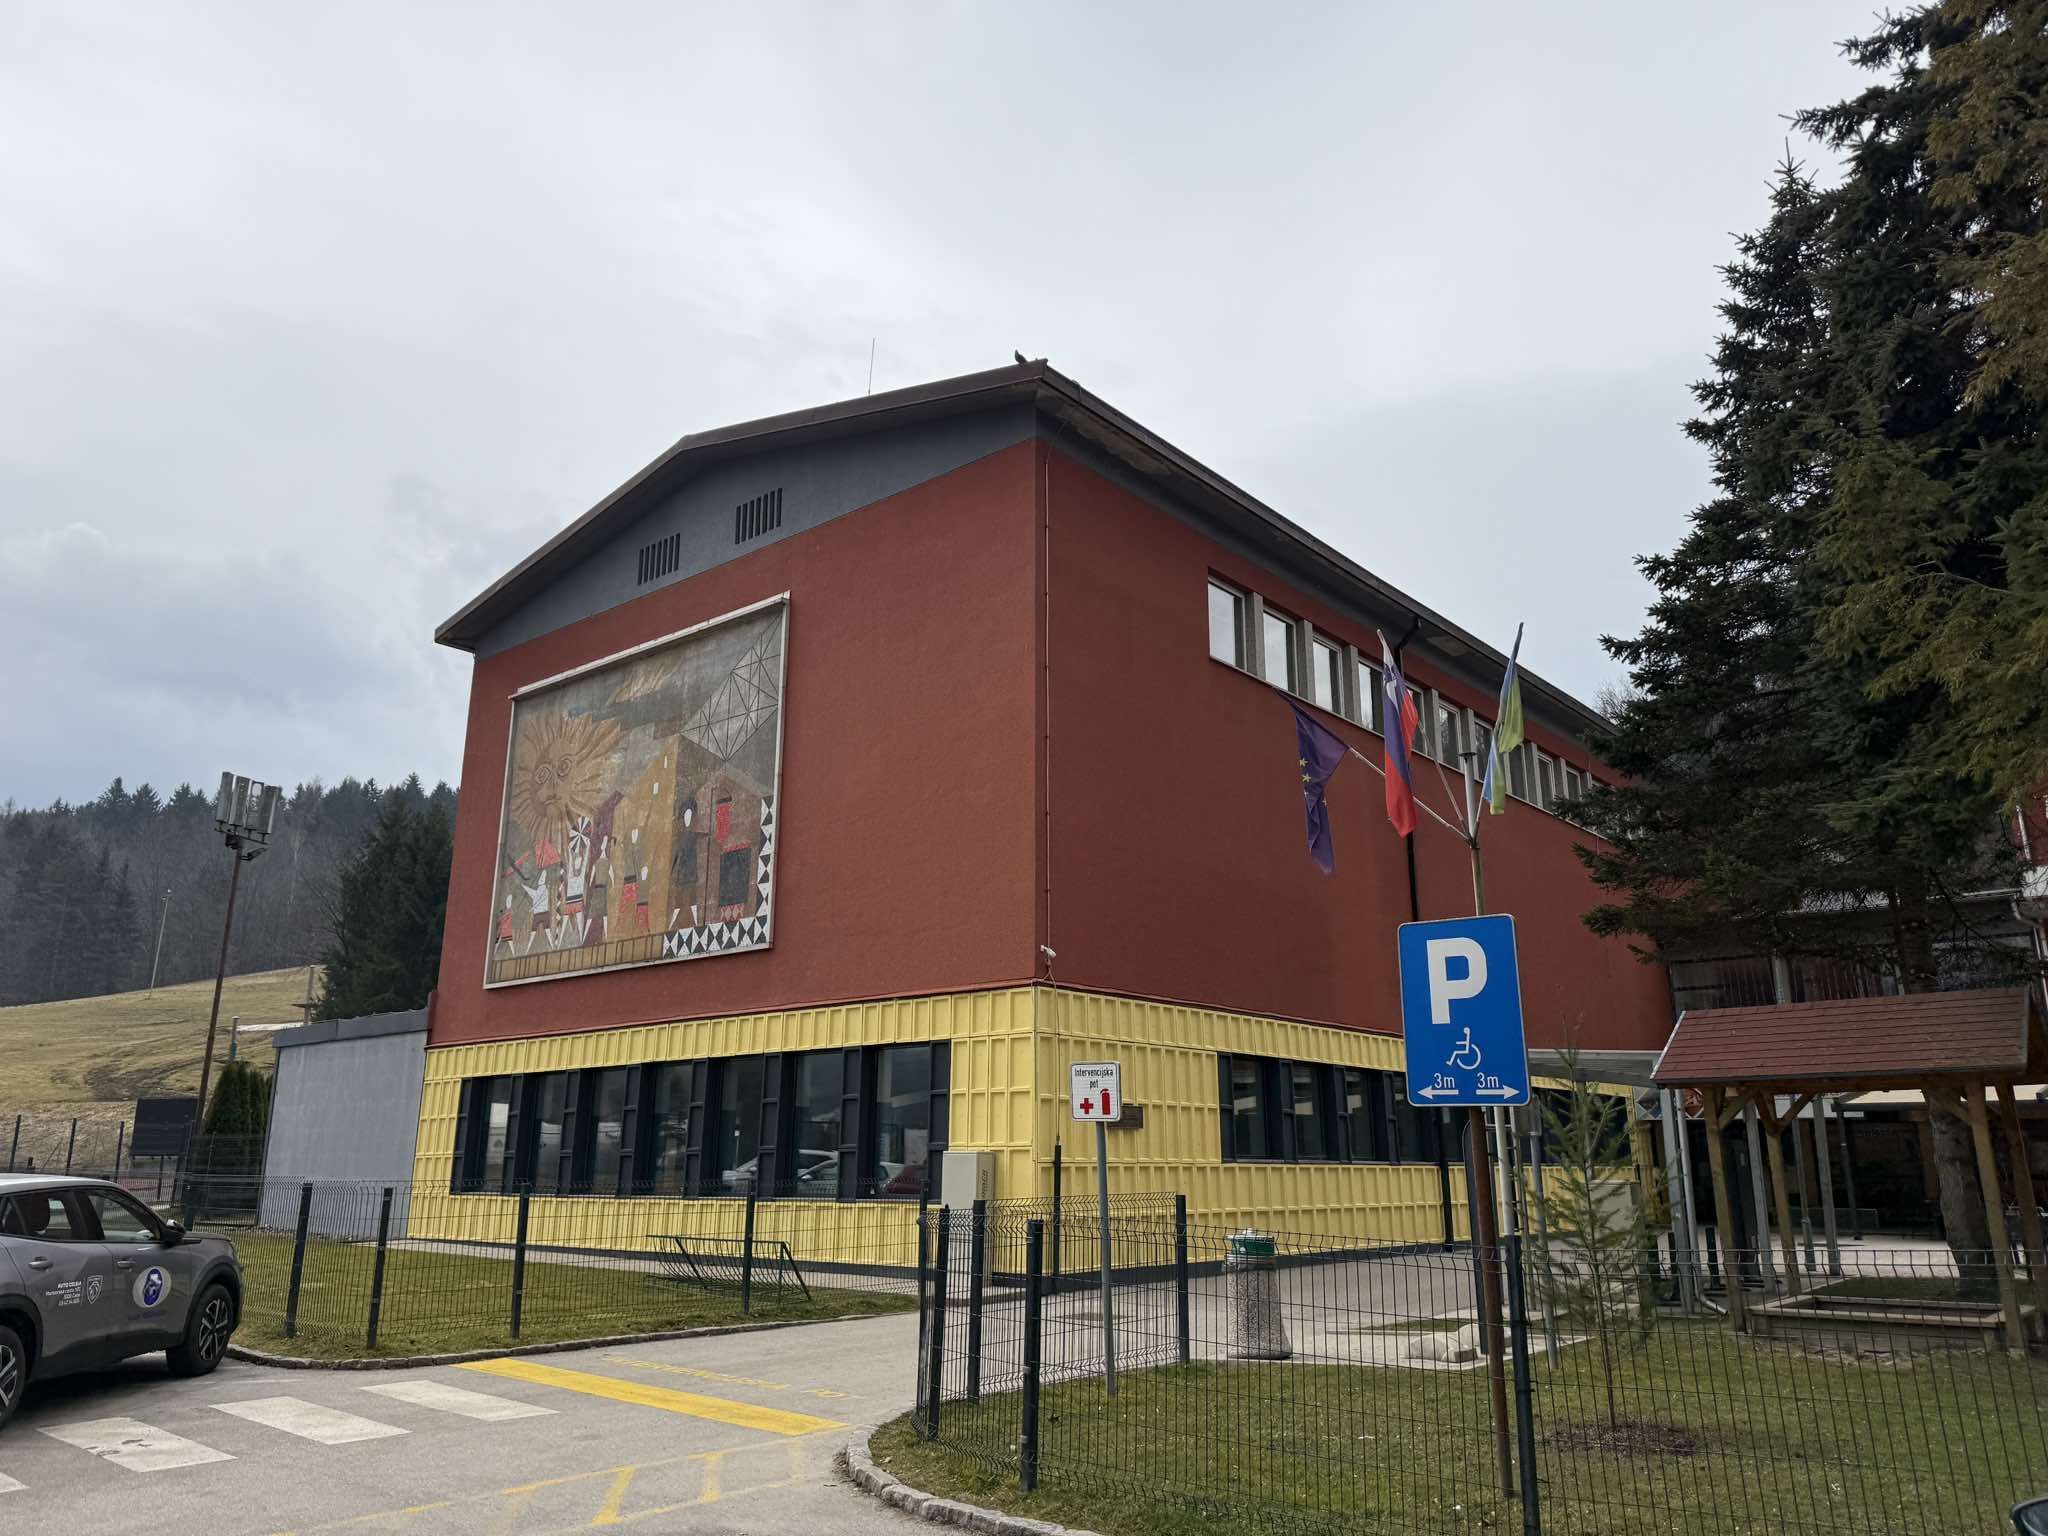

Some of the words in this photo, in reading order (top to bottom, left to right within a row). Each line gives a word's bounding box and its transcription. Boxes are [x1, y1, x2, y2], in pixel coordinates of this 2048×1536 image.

[1427, 937, 1488, 1025] P
[1075, 1067, 1114, 1078] Intervencijska
[1090, 1079, 1099, 1089] pot
[1434, 1073, 1456, 1089] 3m
[1477, 1072, 1499, 1088] 3m
